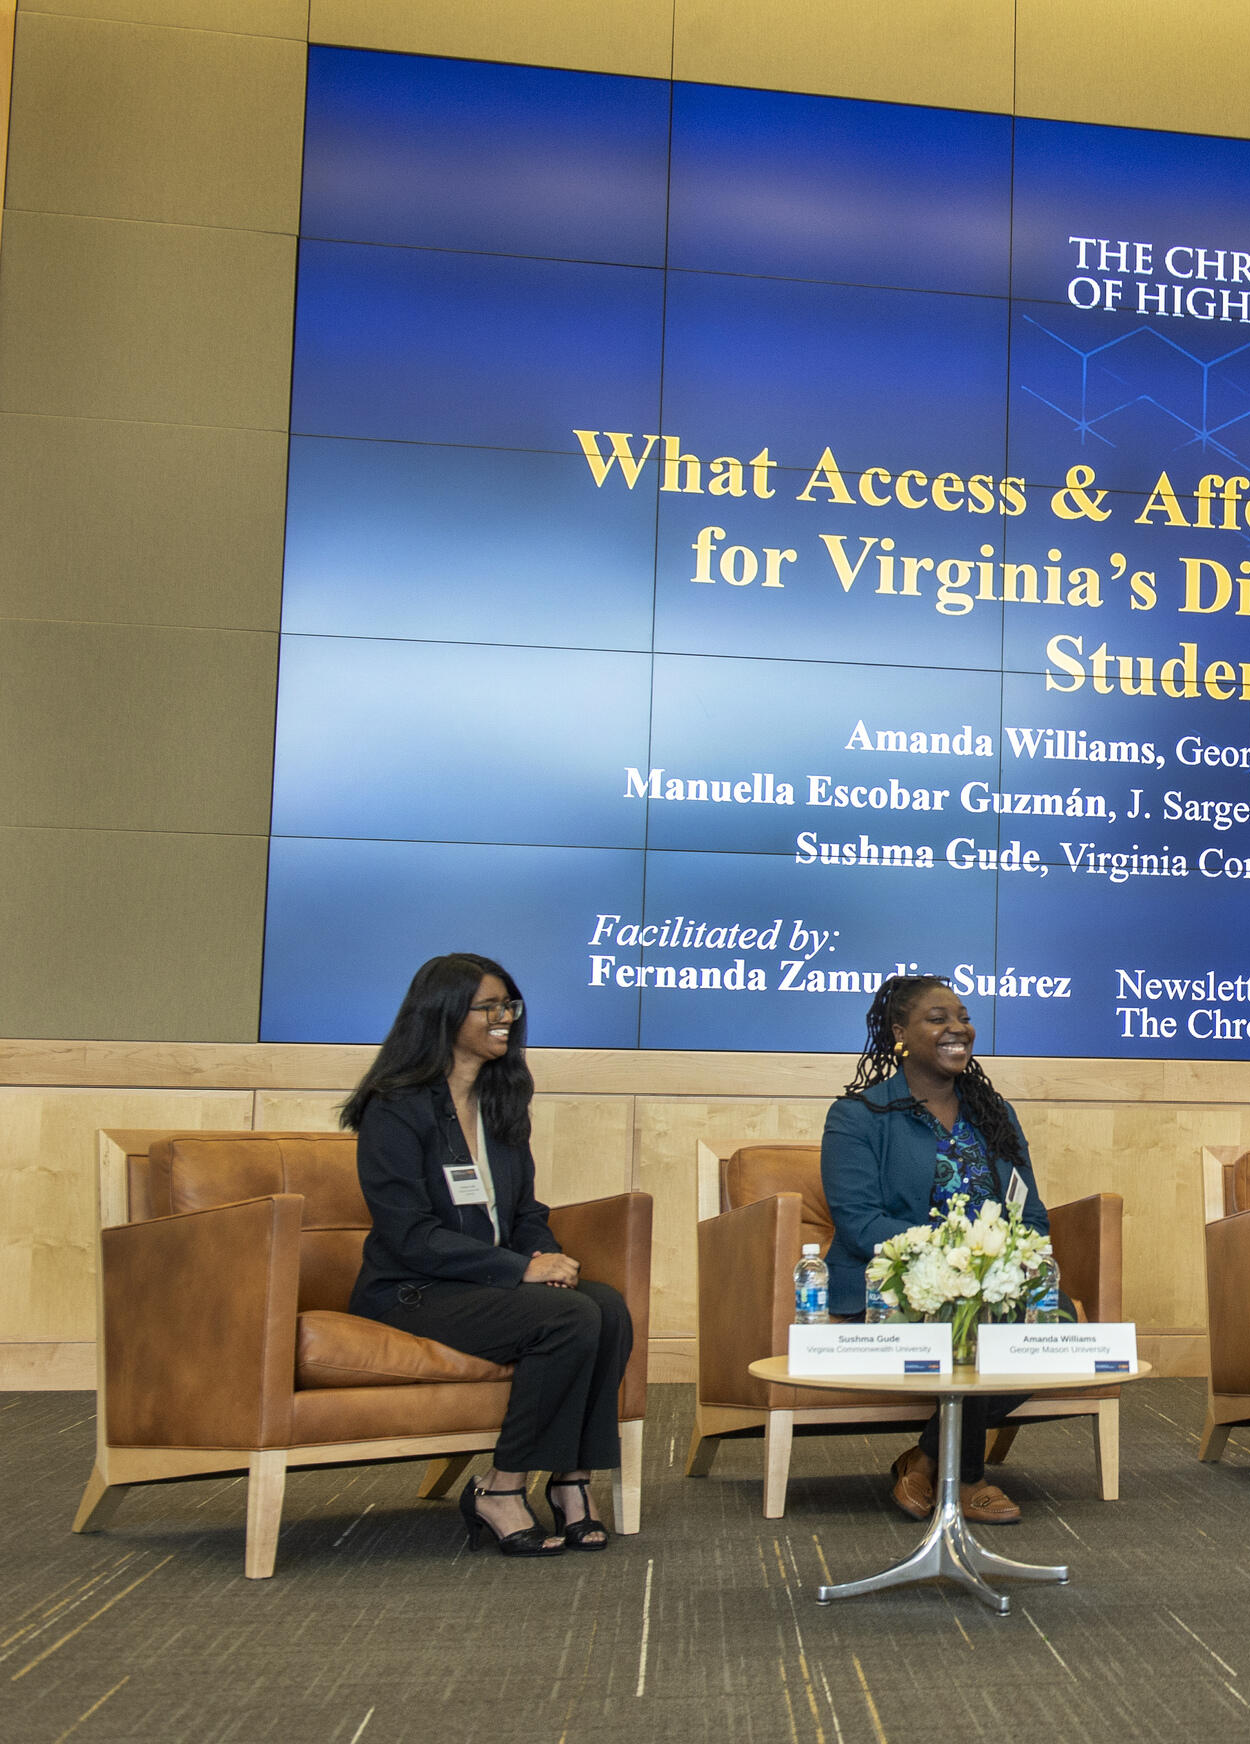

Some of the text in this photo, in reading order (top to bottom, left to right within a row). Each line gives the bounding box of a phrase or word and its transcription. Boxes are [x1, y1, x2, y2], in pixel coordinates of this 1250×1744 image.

[1068, 236, 1154, 275] THE
[1068, 276, 1123, 312] OF
[573, 429, 777, 499] What
[796, 447, 1027, 516] Access
[1050, 464, 1113, 522] &
[691, 526, 798, 587] for
[819, 534, 1158, 616] Virginia’s
[844, 719, 994, 757] Amanda
[1004, 727, 1165, 771] Williams,
[623, 766, 795, 806] Manuella
[805, 775, 950, 811] Escobar
[960, 781, 1117, 824] Guzmán,
[1127, 789, 1151, 819] J.
[795, 831, 935, 869] Sushma
[945, 837, 1049, 878] Gude,
[1059, 842, 1189, 883] Virginia
[587, 914, 841, 960] Facilitated by:
[588, 955, 768, 991] Fernanda
[1115, 1007, 1177, 1038] The
[838, 1334, 900, 1343] Sushma Gude
[1009, 1345, 1111, 1355] George Mason University
[1023, 1335, 1097, 1343] Amanda Williams
